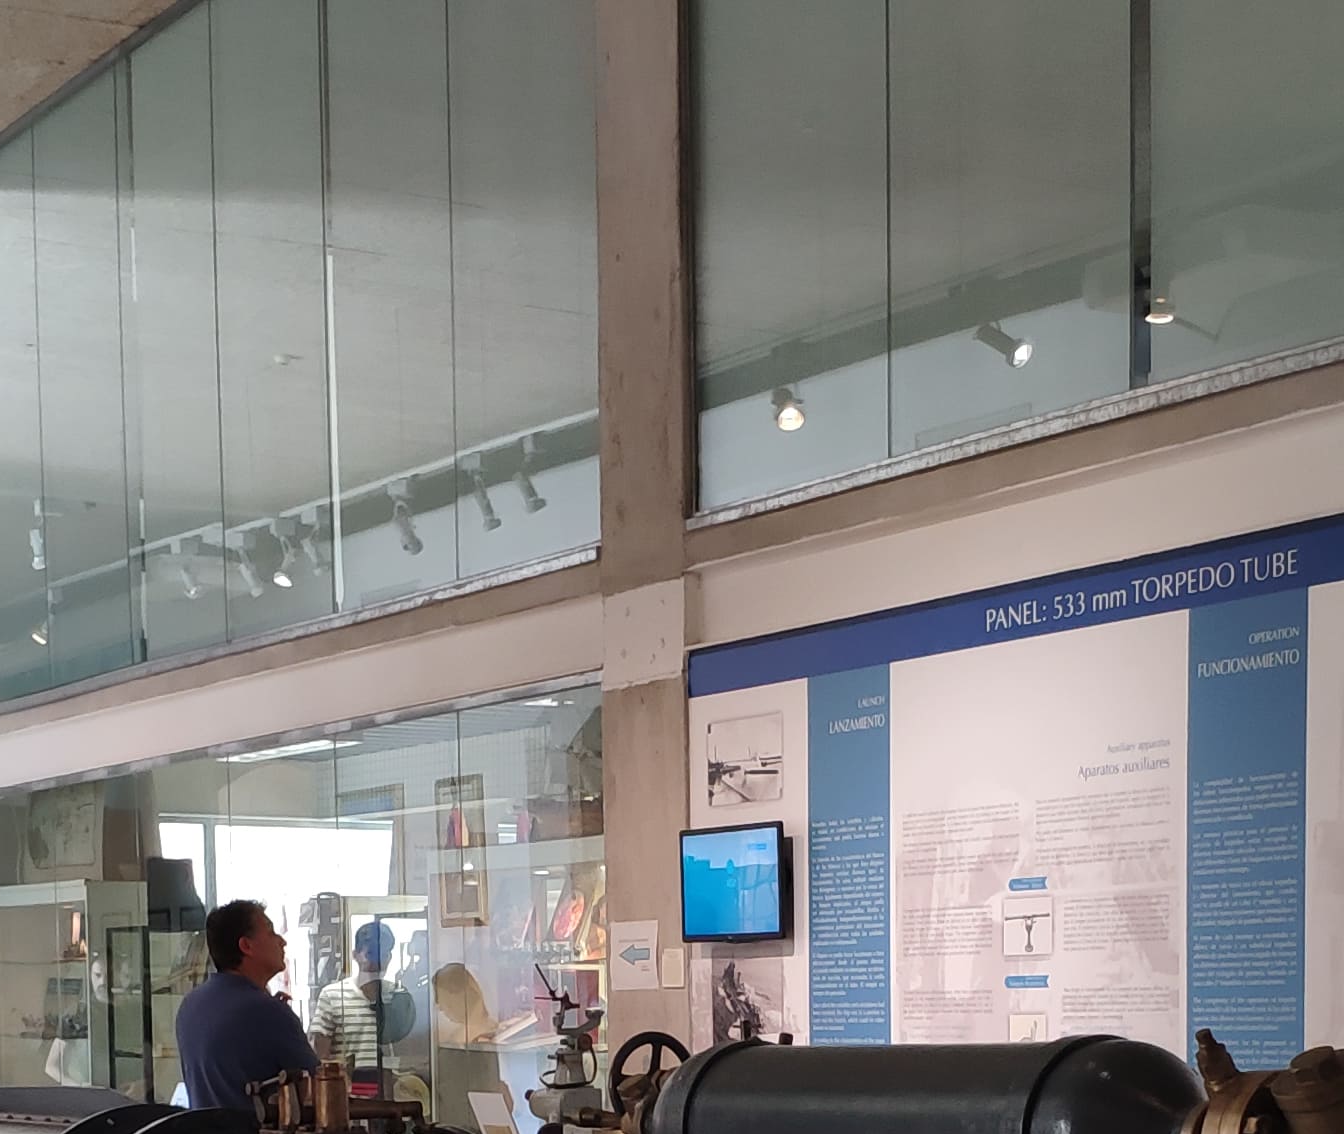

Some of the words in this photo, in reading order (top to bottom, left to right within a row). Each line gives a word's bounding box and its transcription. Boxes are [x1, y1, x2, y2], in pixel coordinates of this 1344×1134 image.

[985, 601, 1048, 633] PANEL:
[1052, 591, 1086, 620] 533
[1092, 588, 1127, 613] mm
[1131, 561, 1235, 604] TORPEDO
[1240, 549, 1299, 584] TUBE
[1248, 626, 1300, 645] OPERATION
[1197, 649, 1300, 678] FUNCIONAMIENTO
[829, 714, 885, 734] LANZAMIENTO
[1078, 764, 1119, 781] Aparatos
[1122, 757, 1169, 773] auxiliares
